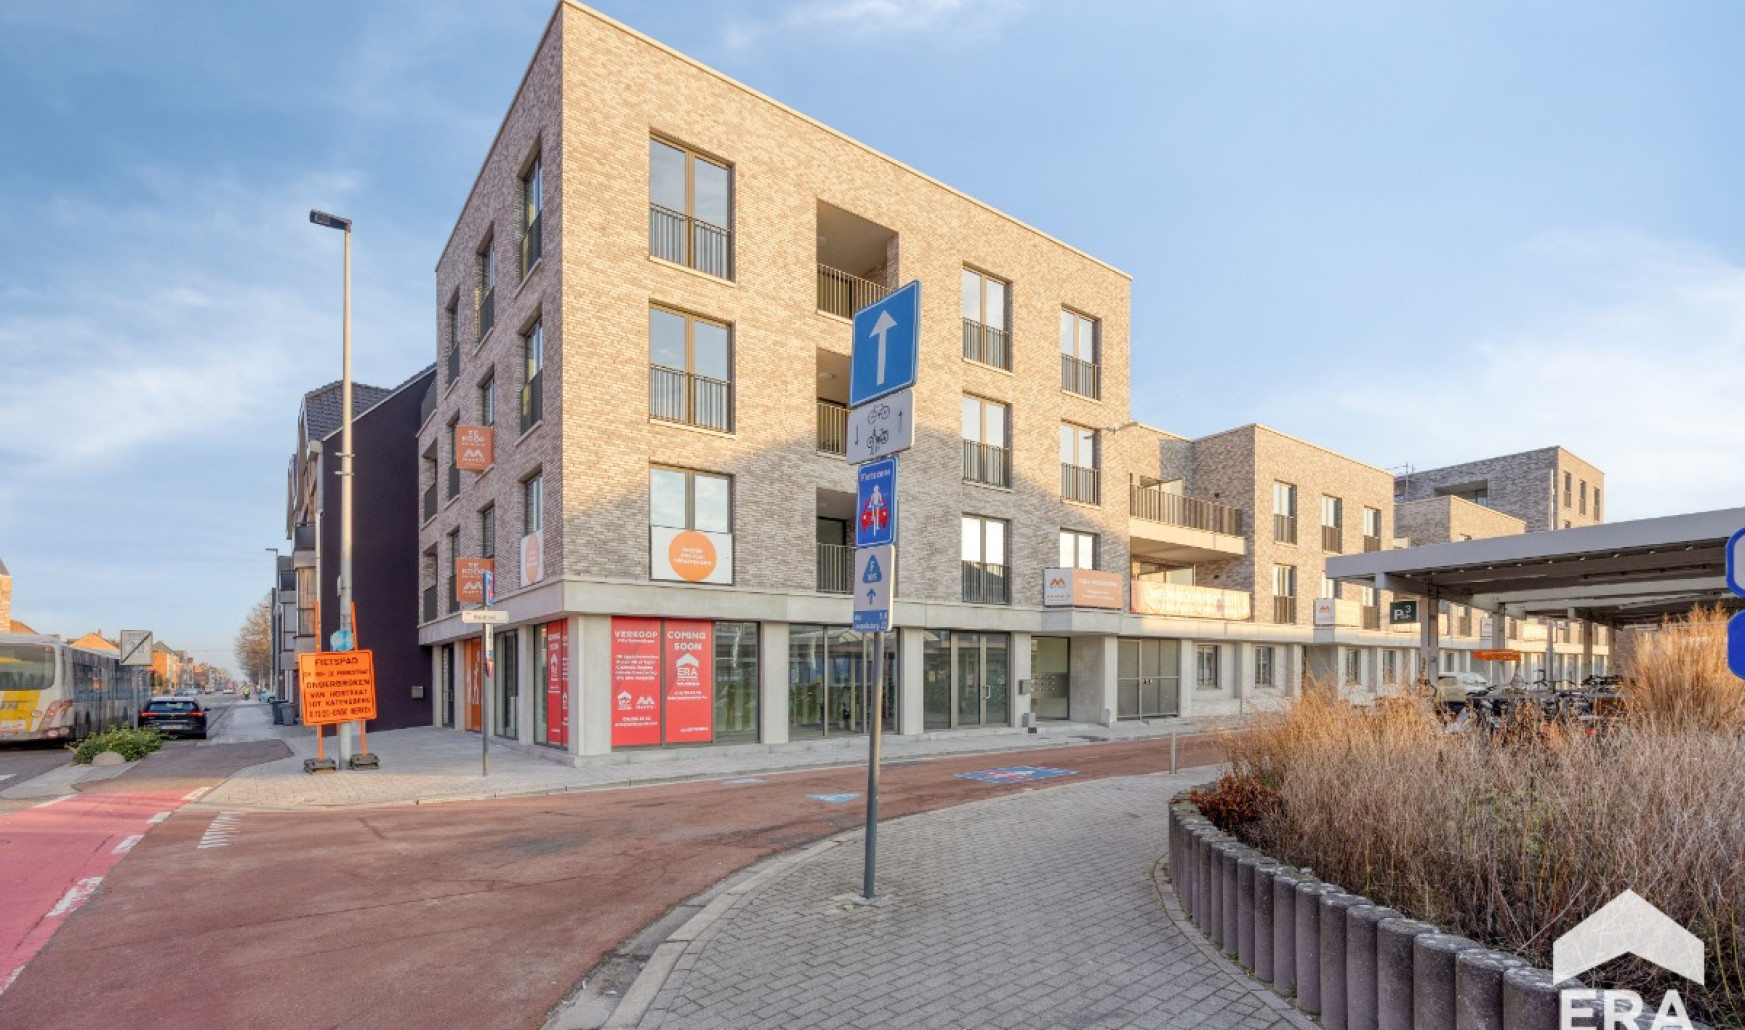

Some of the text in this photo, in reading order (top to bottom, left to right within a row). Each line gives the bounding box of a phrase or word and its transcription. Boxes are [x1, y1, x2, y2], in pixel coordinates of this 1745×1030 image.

[870, 561, 875, 571] F
[1394, 604, 1412, 620] P 3
[614, 630, 658, 638] VERKOOP
[667, 631, 706, 640] COMING
[674, 642, 702, 650] SOON
[315, 657, 359, 666] FIETSPAD
[677, 667, 698, 676] ERA
[307, 679, 370, 689] ONDERBROKEN
